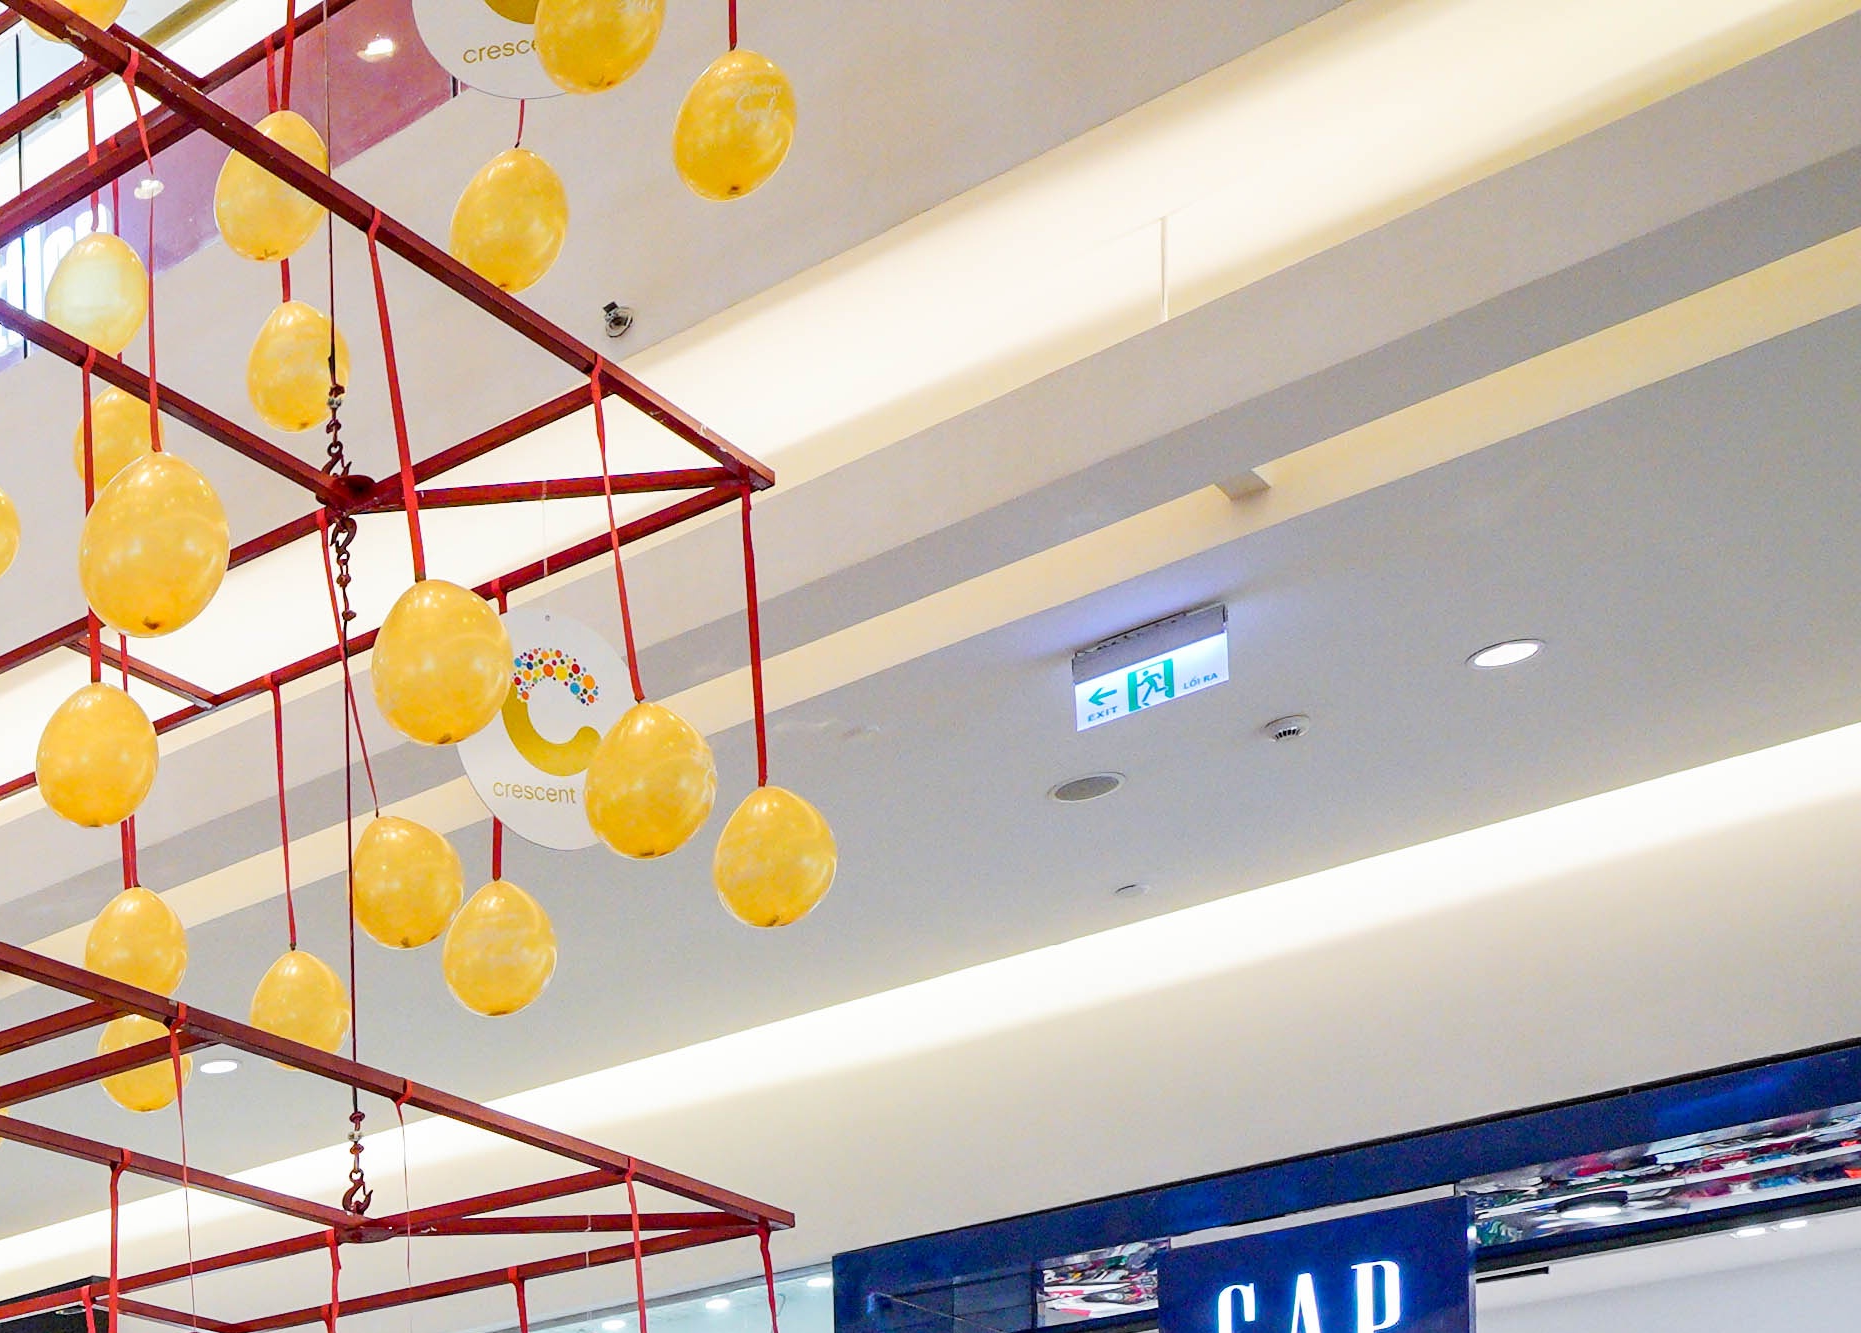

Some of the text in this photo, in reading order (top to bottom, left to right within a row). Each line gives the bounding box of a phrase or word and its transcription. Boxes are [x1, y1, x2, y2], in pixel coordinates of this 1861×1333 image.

[463, 40, 536, 63] cresc
[1204, 672, 1219, 682] RA
[1087, 705, 1118, 722] EXIT
[493, 782, 577, 803] crescent
